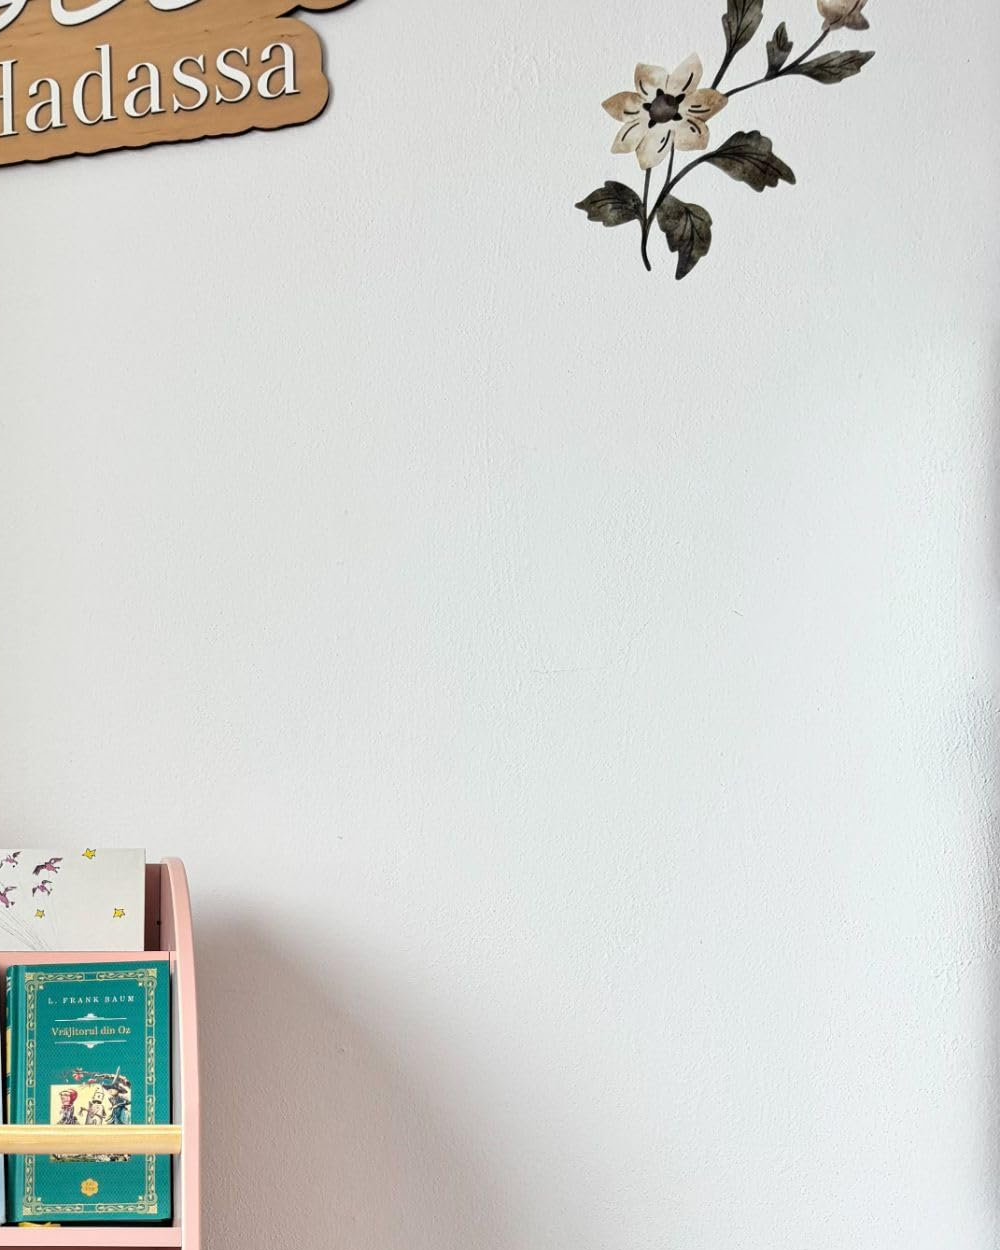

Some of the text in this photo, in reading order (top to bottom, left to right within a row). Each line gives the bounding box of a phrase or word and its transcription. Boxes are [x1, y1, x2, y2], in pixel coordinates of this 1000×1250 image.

[48, 997, 58, 1005] L.
[104, 995, 135, 1003] BAUM
[51, 1025, 131, 1038] Vrăjitorul din Oz
